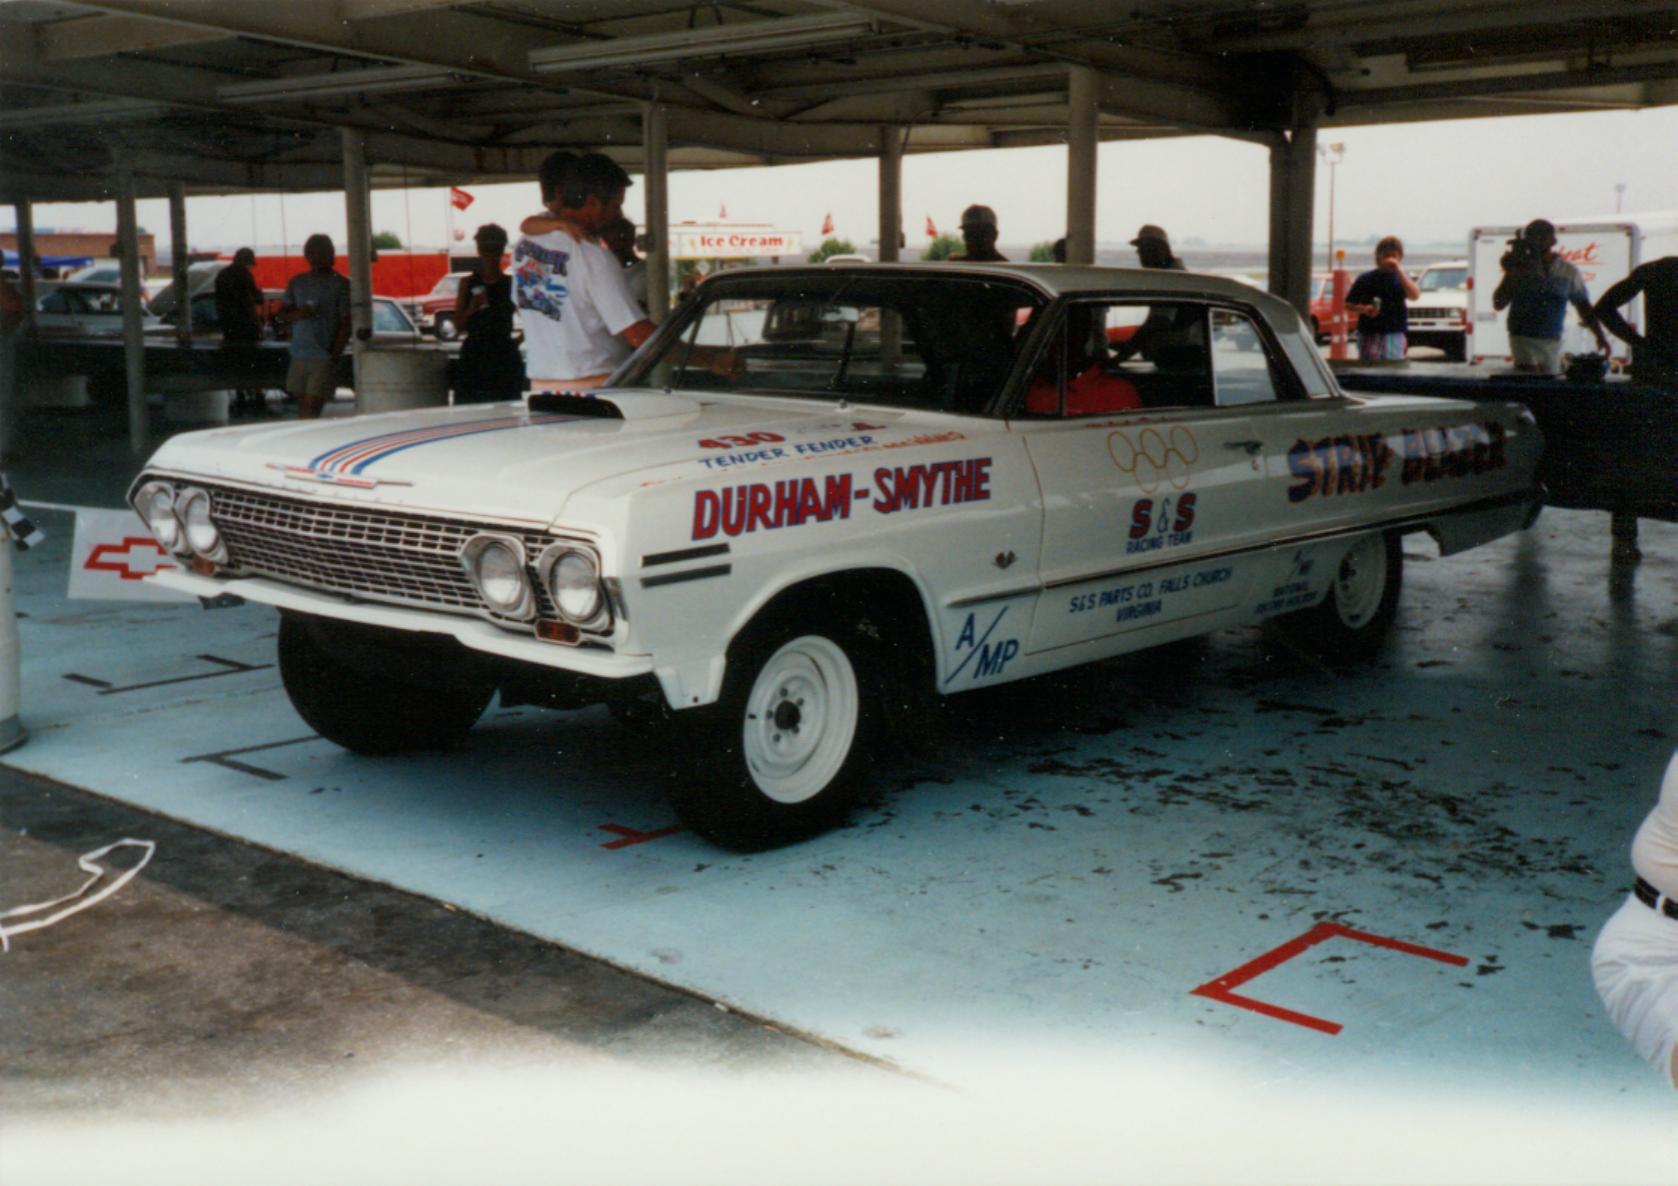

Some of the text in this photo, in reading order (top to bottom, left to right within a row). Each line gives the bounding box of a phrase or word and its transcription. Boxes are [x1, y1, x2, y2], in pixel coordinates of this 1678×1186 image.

[700, 234, 784, 247] Ice Cream
[698, 431, 785, 450] 430
[698, 447, 789, 470] TENDER
[794, 435, 876, 454] FENDER
[691, 457, 993, 541] DURHAM-SMYTHE
[1167, 531, 1193, 547] TEAM
[1098, 585, 1135, 606] PARTS
[1158, 574, 1189, 595] FALLS
[1192, 566, 1234, 589] CHURCH
[1116, 600, 1163, 622] VIRGINIA
